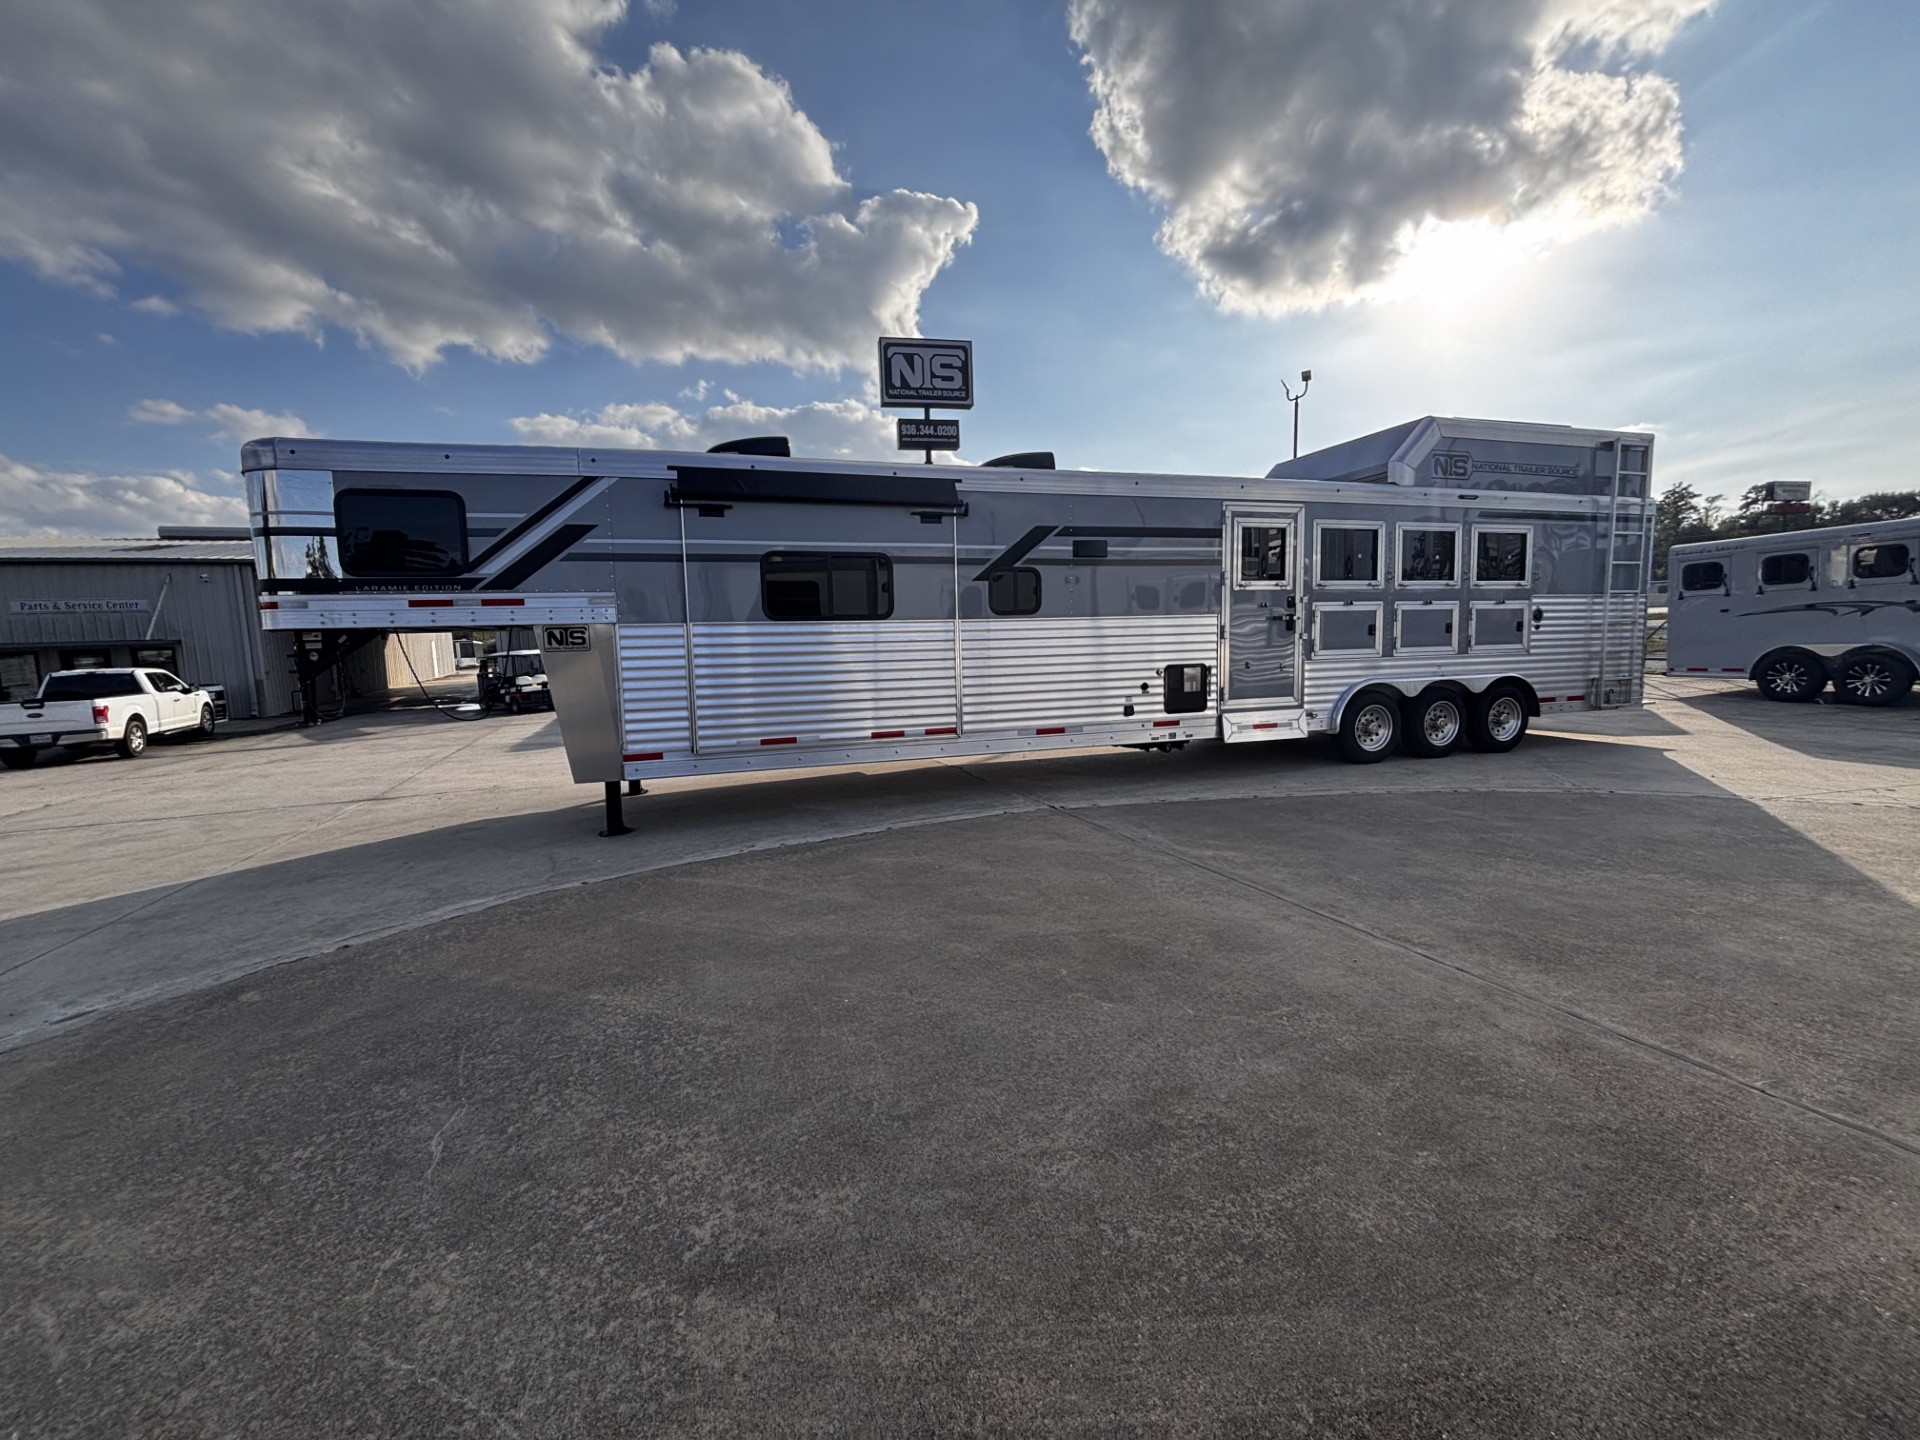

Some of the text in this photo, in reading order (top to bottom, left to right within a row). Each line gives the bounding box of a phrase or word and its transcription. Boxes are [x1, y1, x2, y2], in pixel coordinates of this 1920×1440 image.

[942, 390, 966, 398] SOURCE
[901, 424, 957, 436] 936.344.0200
[1472, 462, 1511, 473] NATIONAL
[1513, 464, 1546, 475] TRAILER
[1547, 466, 1579, 476] SOURCE
[20, 600, 140, 611] Parts & Service Center
